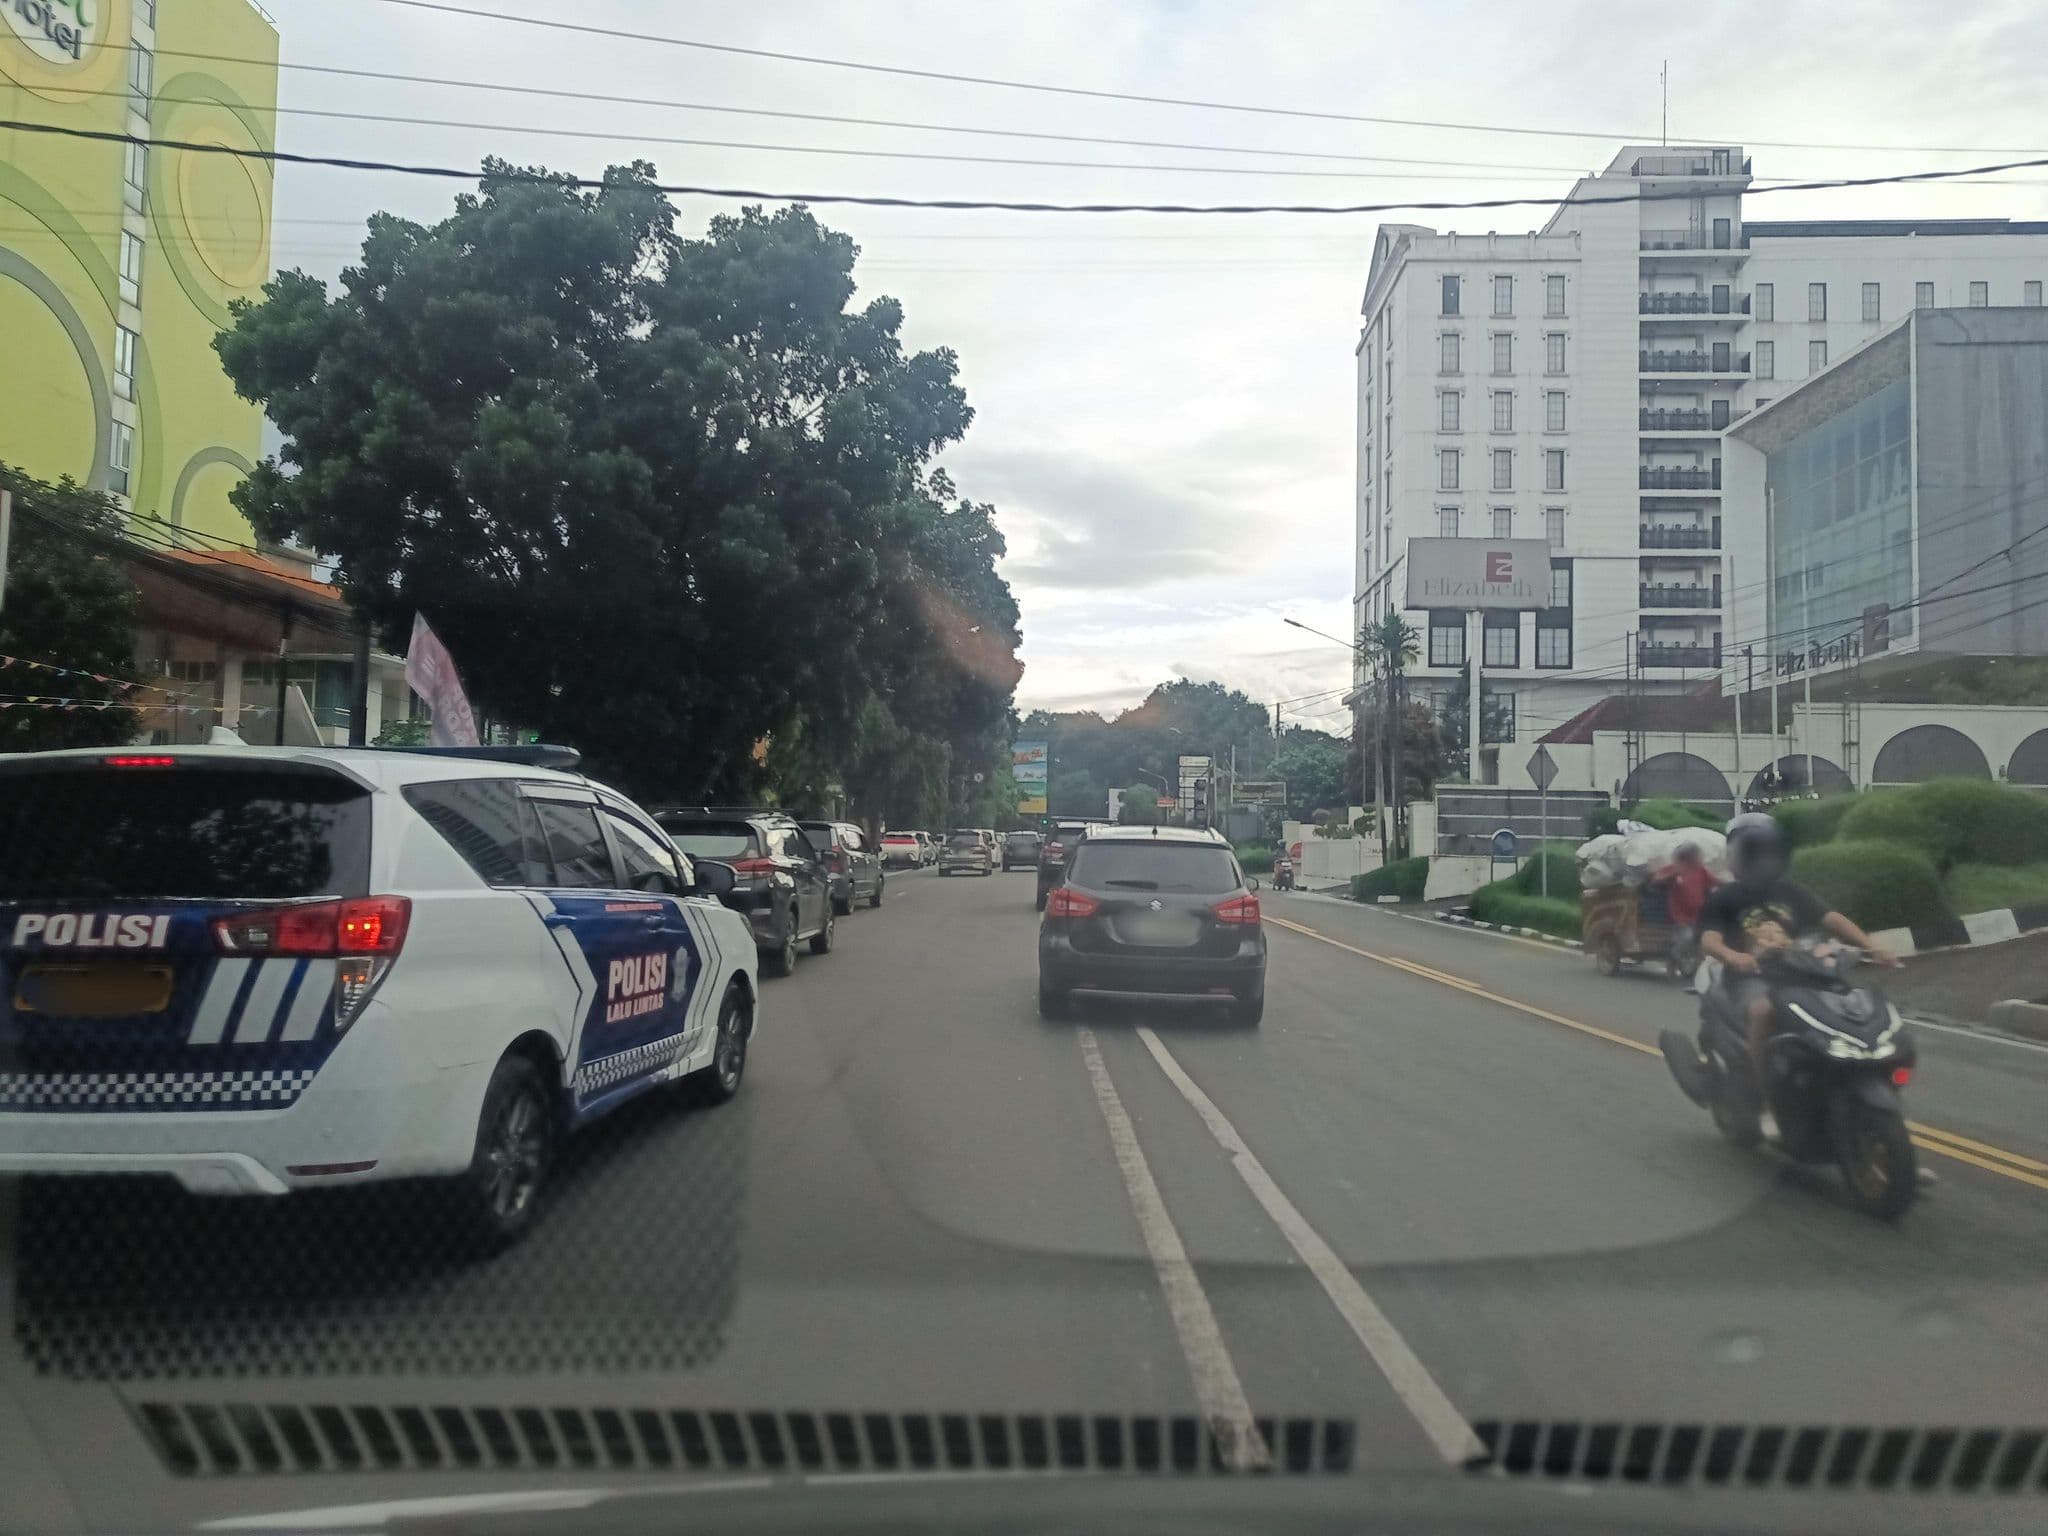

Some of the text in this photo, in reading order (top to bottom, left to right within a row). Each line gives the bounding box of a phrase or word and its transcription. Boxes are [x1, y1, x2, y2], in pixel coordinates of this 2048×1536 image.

[1424, 578, 1533, 597] Elizabeth
[12, 914, 172, 948] POLISI
[609, 953, 667, 1000] POLISI
[606, 993, 664, 1023] LALU LINTAS
